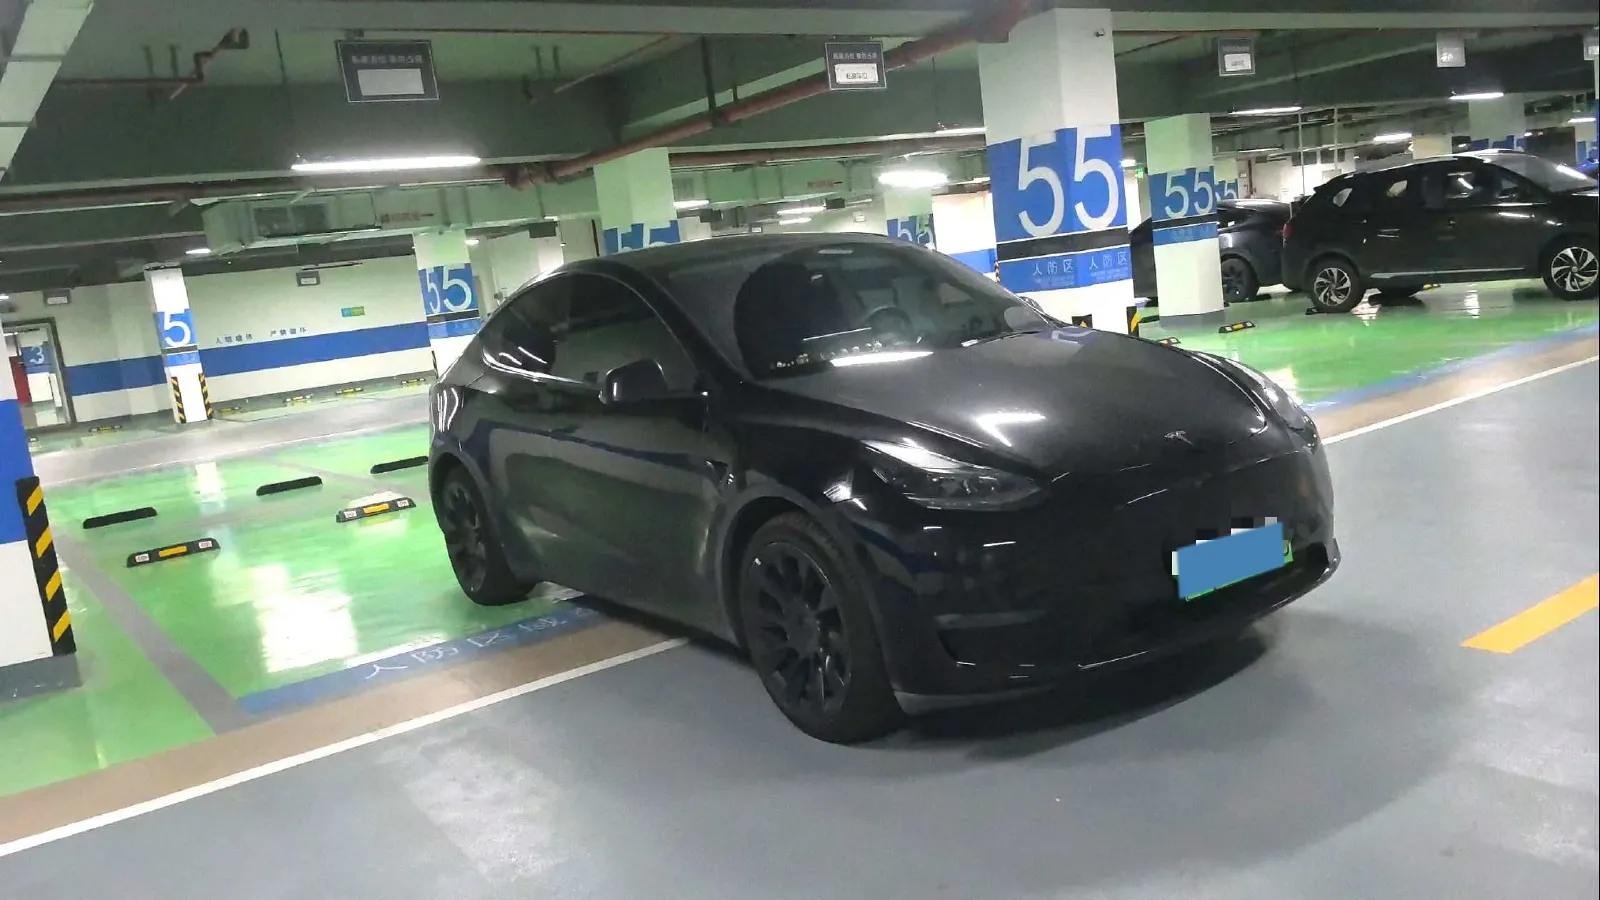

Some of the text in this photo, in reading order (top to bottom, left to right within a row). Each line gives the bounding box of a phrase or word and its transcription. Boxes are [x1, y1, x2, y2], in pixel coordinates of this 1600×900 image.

[1033, 258, 1074, 277] 人防区
[1089, 251, 1127, 270] 人防区
[164, 310, 191, 347] 5
